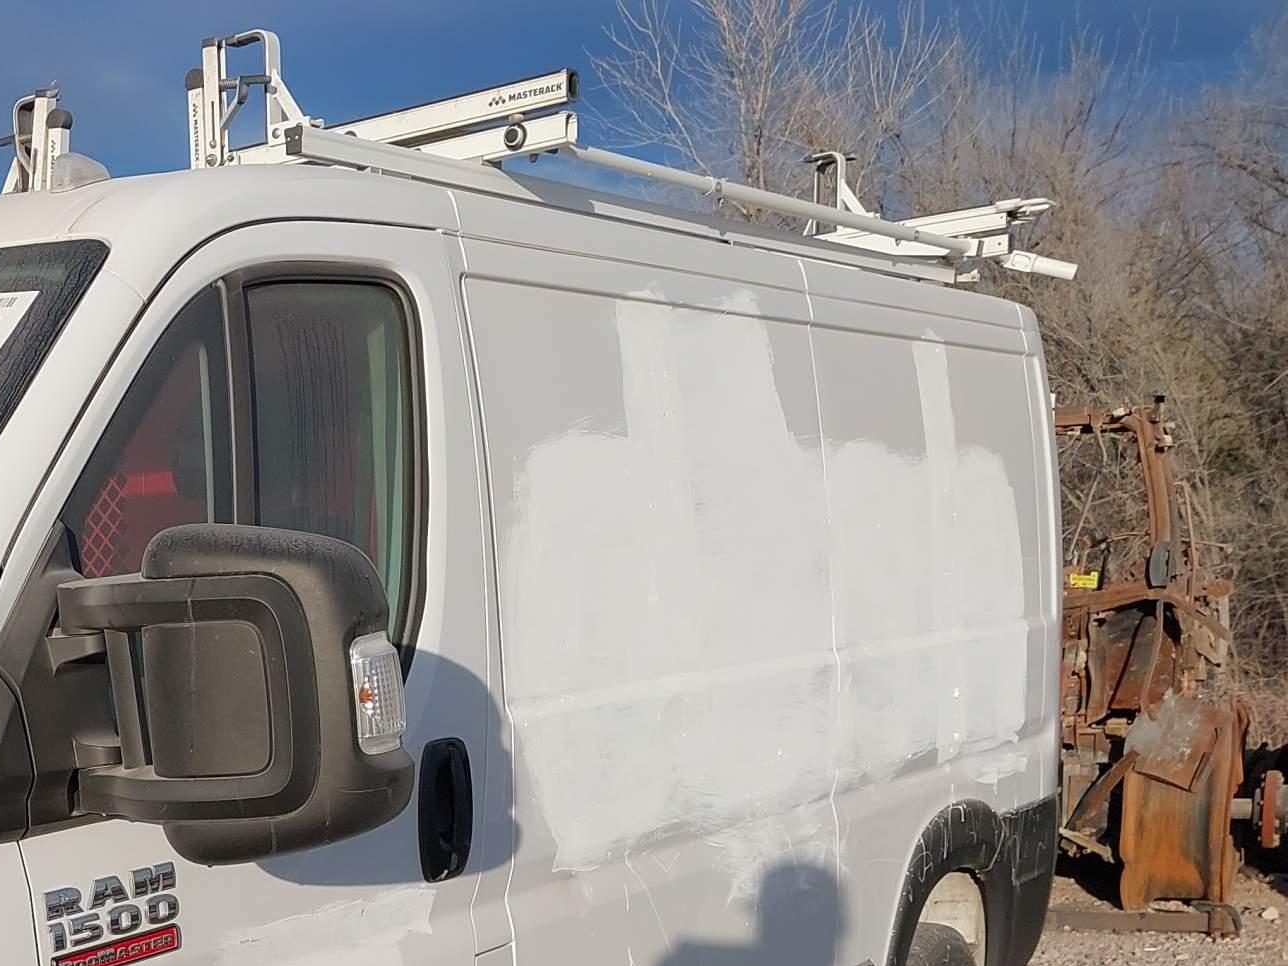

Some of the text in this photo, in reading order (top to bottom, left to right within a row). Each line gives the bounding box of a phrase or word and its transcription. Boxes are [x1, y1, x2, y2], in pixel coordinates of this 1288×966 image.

[508, 82, 562, 102] MASTERACK
[44, 861, 177, 922] RAM
[48, 893, 180, 952] 1500
